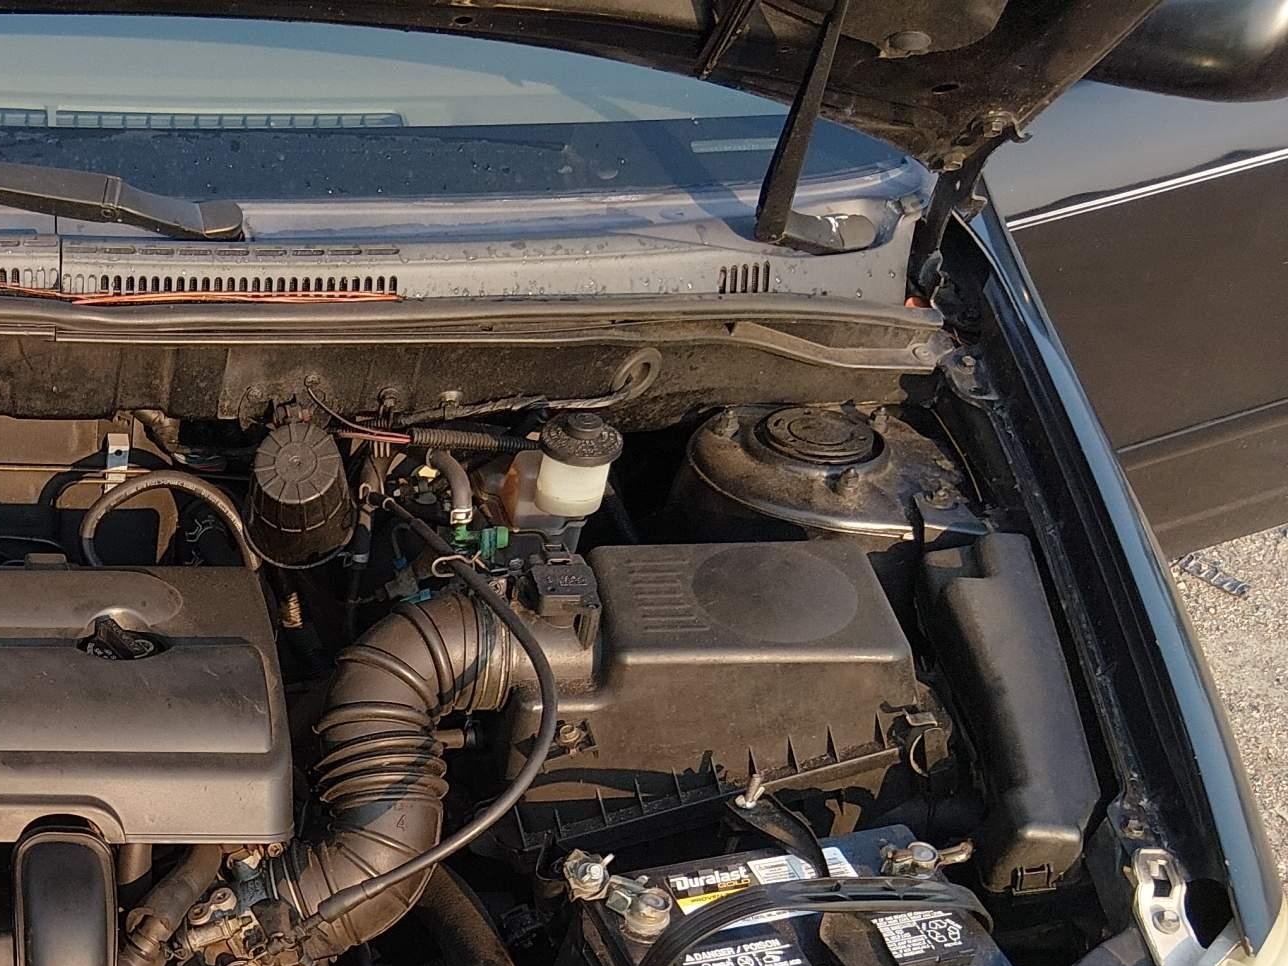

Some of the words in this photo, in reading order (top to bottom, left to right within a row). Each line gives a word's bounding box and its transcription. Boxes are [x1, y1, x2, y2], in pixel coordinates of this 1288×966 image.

[669, 864, 749, 892] Duralast
[717, 877, 752, 890] GOLD
[693, 946, 736, 962] DANGER
[744, 938, 782, 953] POISON
